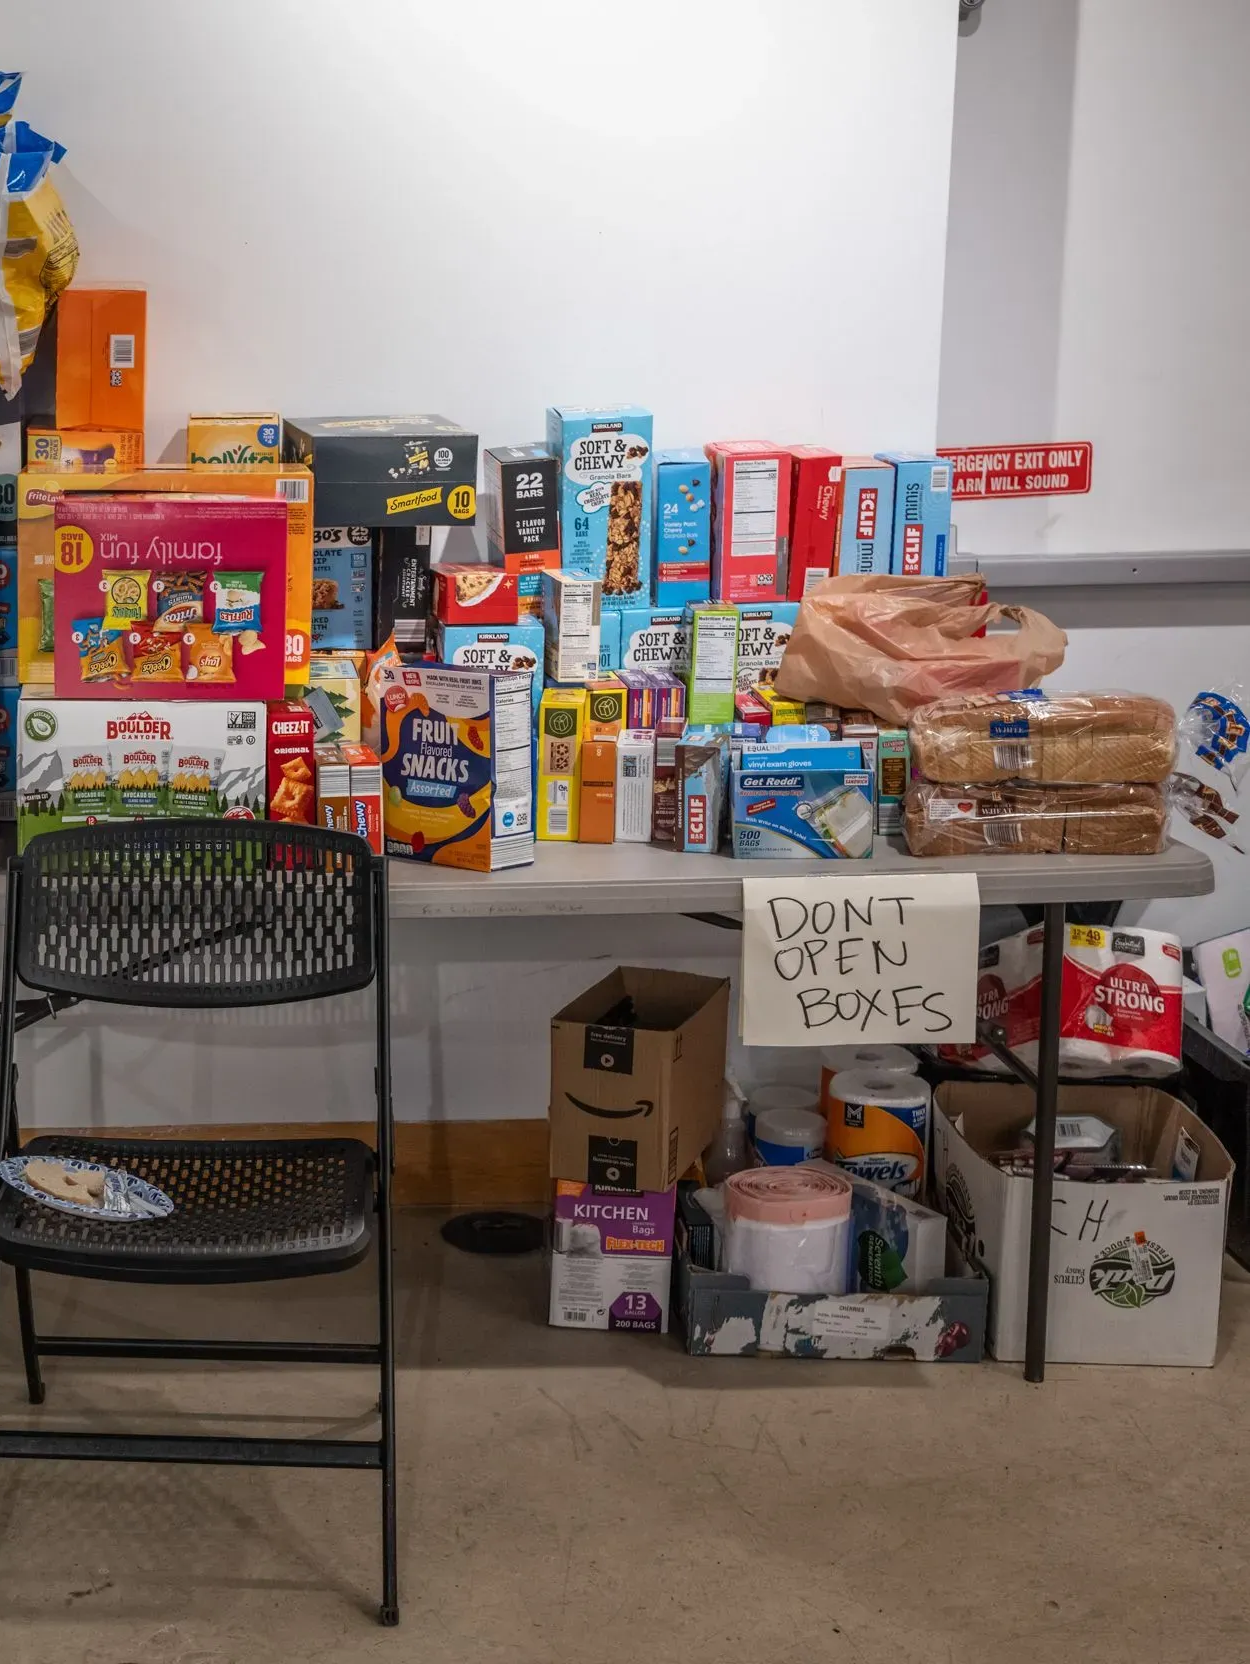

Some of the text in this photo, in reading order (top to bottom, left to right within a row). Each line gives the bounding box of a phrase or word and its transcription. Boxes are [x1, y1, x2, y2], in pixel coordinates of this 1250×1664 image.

[263, 428, 274, 437] 30
[35, 438, 49, 460] 30
[438, 450, 449, 458] 100
[579, 439, 627, 456] SOFT &
[575, 455, 626, 471] CHEWY
[1015, 452, 1045, 469] EXIT
[1049, 450, 1083, 467] ONLY
[516, 472, 543, 490] 22
[991, 477, 1021, 490] WILL
[1025, 474, 1069, 489] SOUND
[390, 491, 438, 511] Smartfood
[454, 491, 470, 508] 10
[516, 490, 543, 499] BARS
[819, 485, 833, 520] Chewy
[905, 483, 920, 521] minis
[664, 504, 678, 514] 24
[523, 518, 545, 527] FLAVOR
[574, 517, 589, 530] 64
[859, 499, 875, 536] CLIF
[61, 533, 84, 541] BAGS
[100, 533, 118, 541] MIX
[518, 527, 544, 536] VARIETY
[523, 534, 539, 543] PACK
[100, 536, 223, 565] family fun
[905, 527, 921, 563] CLIF
[61, 542, 83, 565] 18
[220, 609, 253, 621] RUFFLES
[639, 633, 670, 647] SOFT
[90, 652, 118, 672] Cheetos
[463, 650, 512, 664] SOFT &
[634, 647, 682, 662] CHEWY
[142, 654, 172, 674] Cheetos
[107, 720, 171, 740] BOULDER
[412, 718, 460, 745] FRUIT
[420, 743, 452, 757] Flavored
[73, 757, 103, 768] BOULDER
[124, 753, 156, 764] BOULDER
[178, 758, 209, 769] BOULDER
[748, 760, 766, 768] vinyl
[788, 760, 812, 769] gloves
[401, 753, 469, 783] SNACKS
[410, 780, 453, 798] Assorted
[744, 776, 797, 787] Get Reddi
[690, 798, 704, 833] CLIF
[739, 830, 760, 840] 500
[767, 896, 914, 942] DONT
[1086, 929, 1101, 940] 48
[774, 938, 908, 980] OPEN
[1110, 976, 1149, 993] ULTRA
[1094, 985, 1165, 1013] STRONG
[797, 986, 952, 1032] BOXES
[574, 1204, 649, 1221] KITCHEN
[632, 1225, 655, 1236] Bags
[605, 1236, 665, 1252] FLEX-TECH
[874, 1237, 884, 1287] Seventh
[1054, 1274, 1085, 1285] CITRUS
[625, 1294, 647, 1310] 13
[615, 1320, 656, 1329] 200 BAGS
